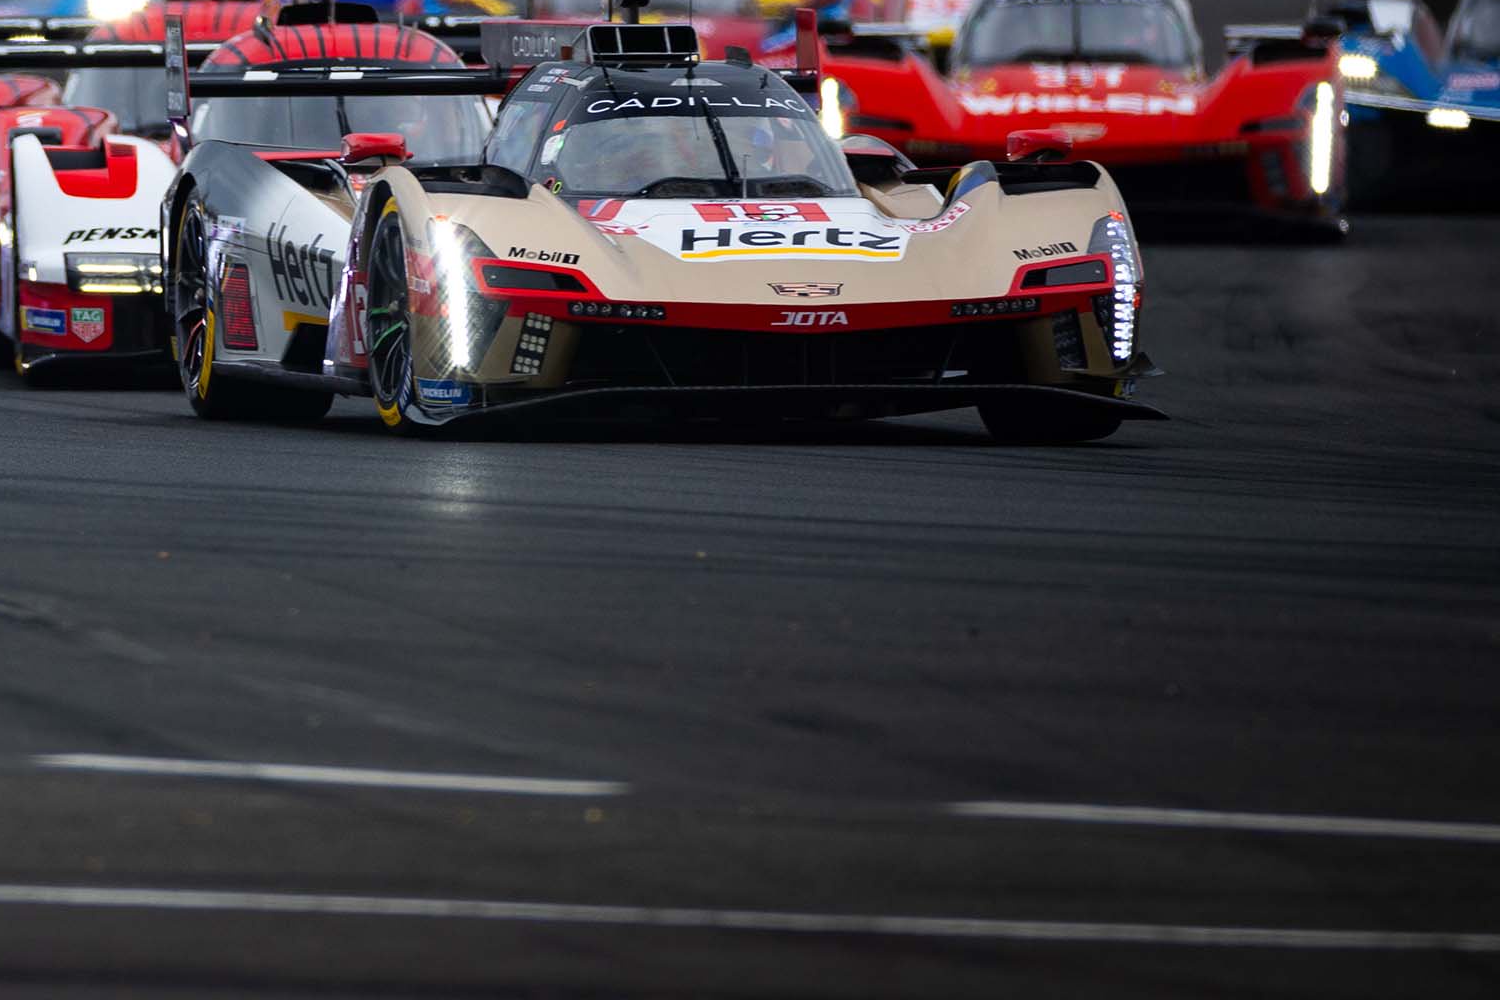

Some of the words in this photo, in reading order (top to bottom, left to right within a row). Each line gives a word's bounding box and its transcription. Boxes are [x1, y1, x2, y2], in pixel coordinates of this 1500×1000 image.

[587, 96, 806, 113] CADILLAC
[960, 93, 1197, 115] WHELEN
[63, 226, 160, 246] PENSK
[681, 227, 901, 251] Hertz
[266, 222, 336, 311] Hertz
[73, 310, 103, 322] TAG
[770, 311, 849, 326] JOTA
